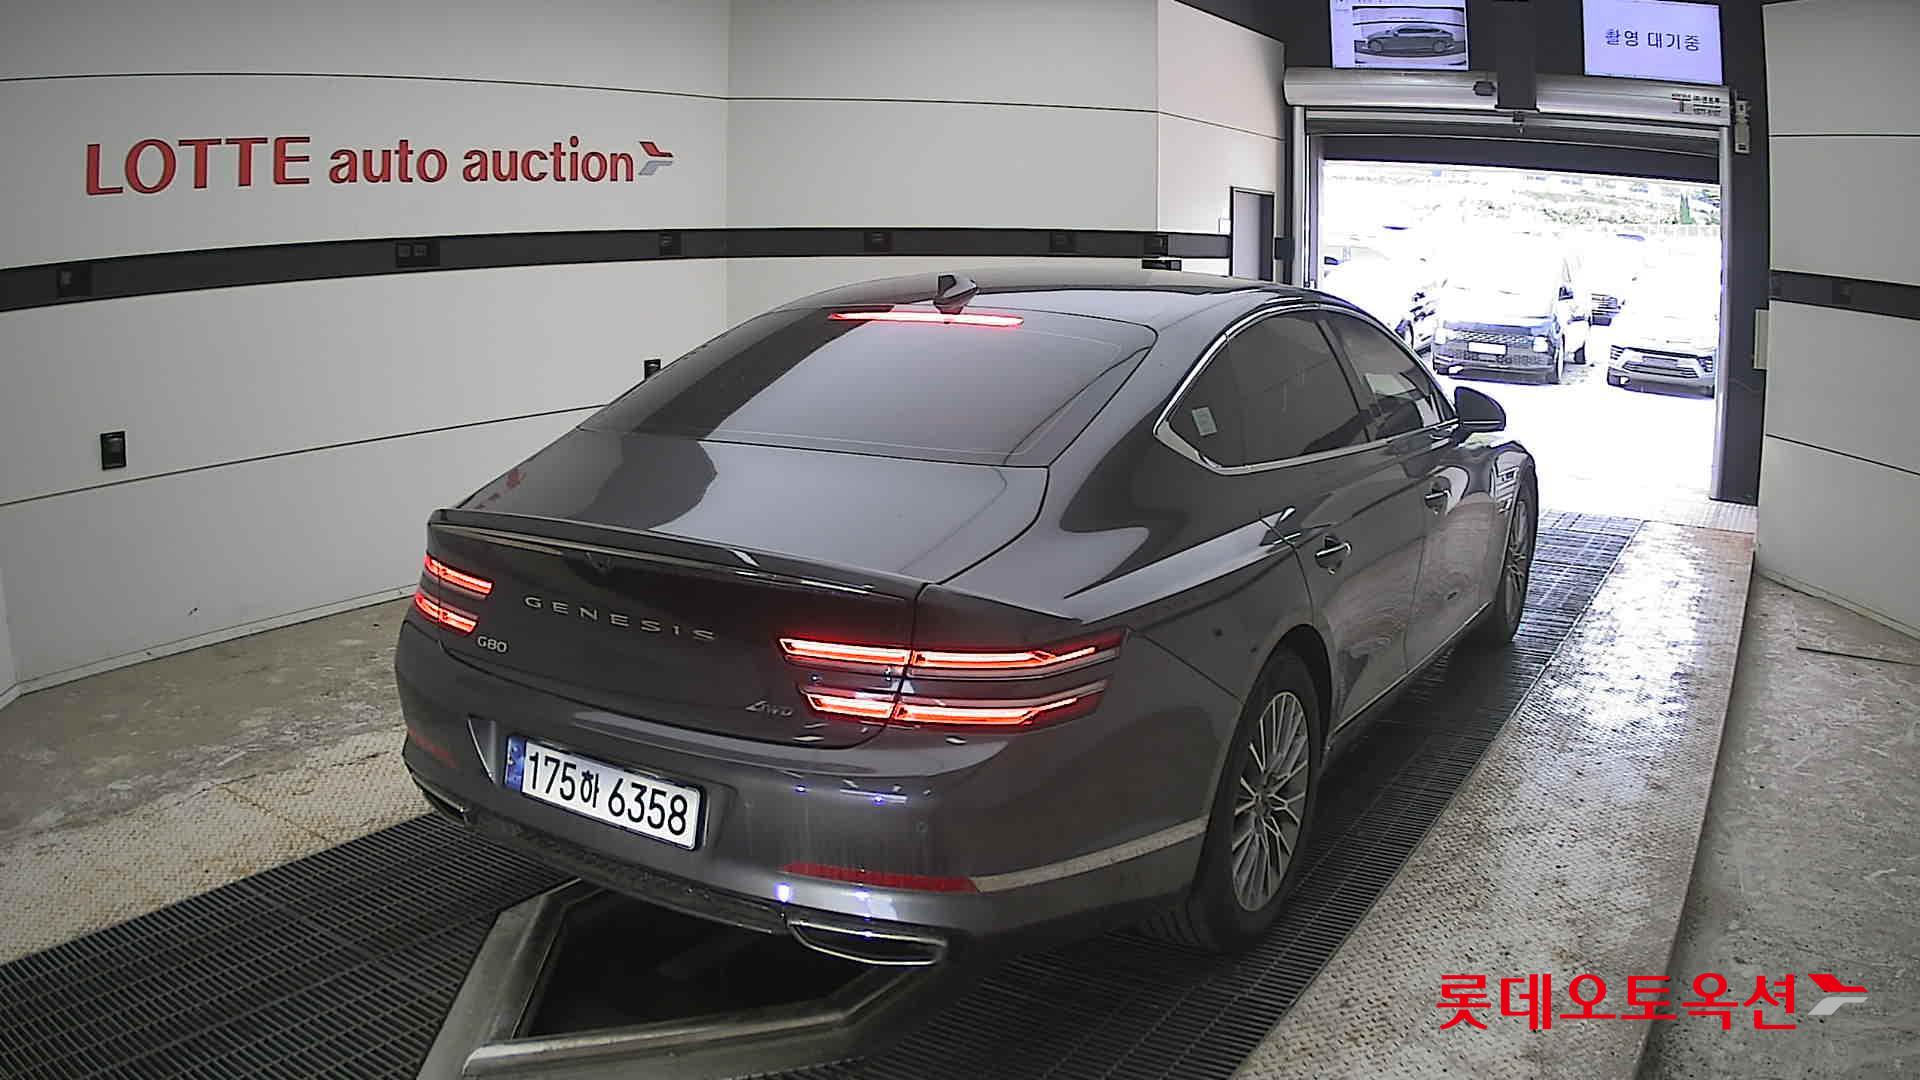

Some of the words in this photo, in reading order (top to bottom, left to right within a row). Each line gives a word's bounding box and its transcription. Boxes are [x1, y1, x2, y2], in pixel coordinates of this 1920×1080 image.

[1605, 28, 1640, 47] 촬영
[1647, 32, 1700, 51] 대기중
[86, 137, 310, 195] LOTTE
[329, 139, 448, 183] auto
[462, 136, 634, 182] auction
[524, 595, 716, 641] GENESIS
[477, 635, 508, 653] G80
[528, 752, 600, 808] 175하
[607, 777, 688, 836] 6358
